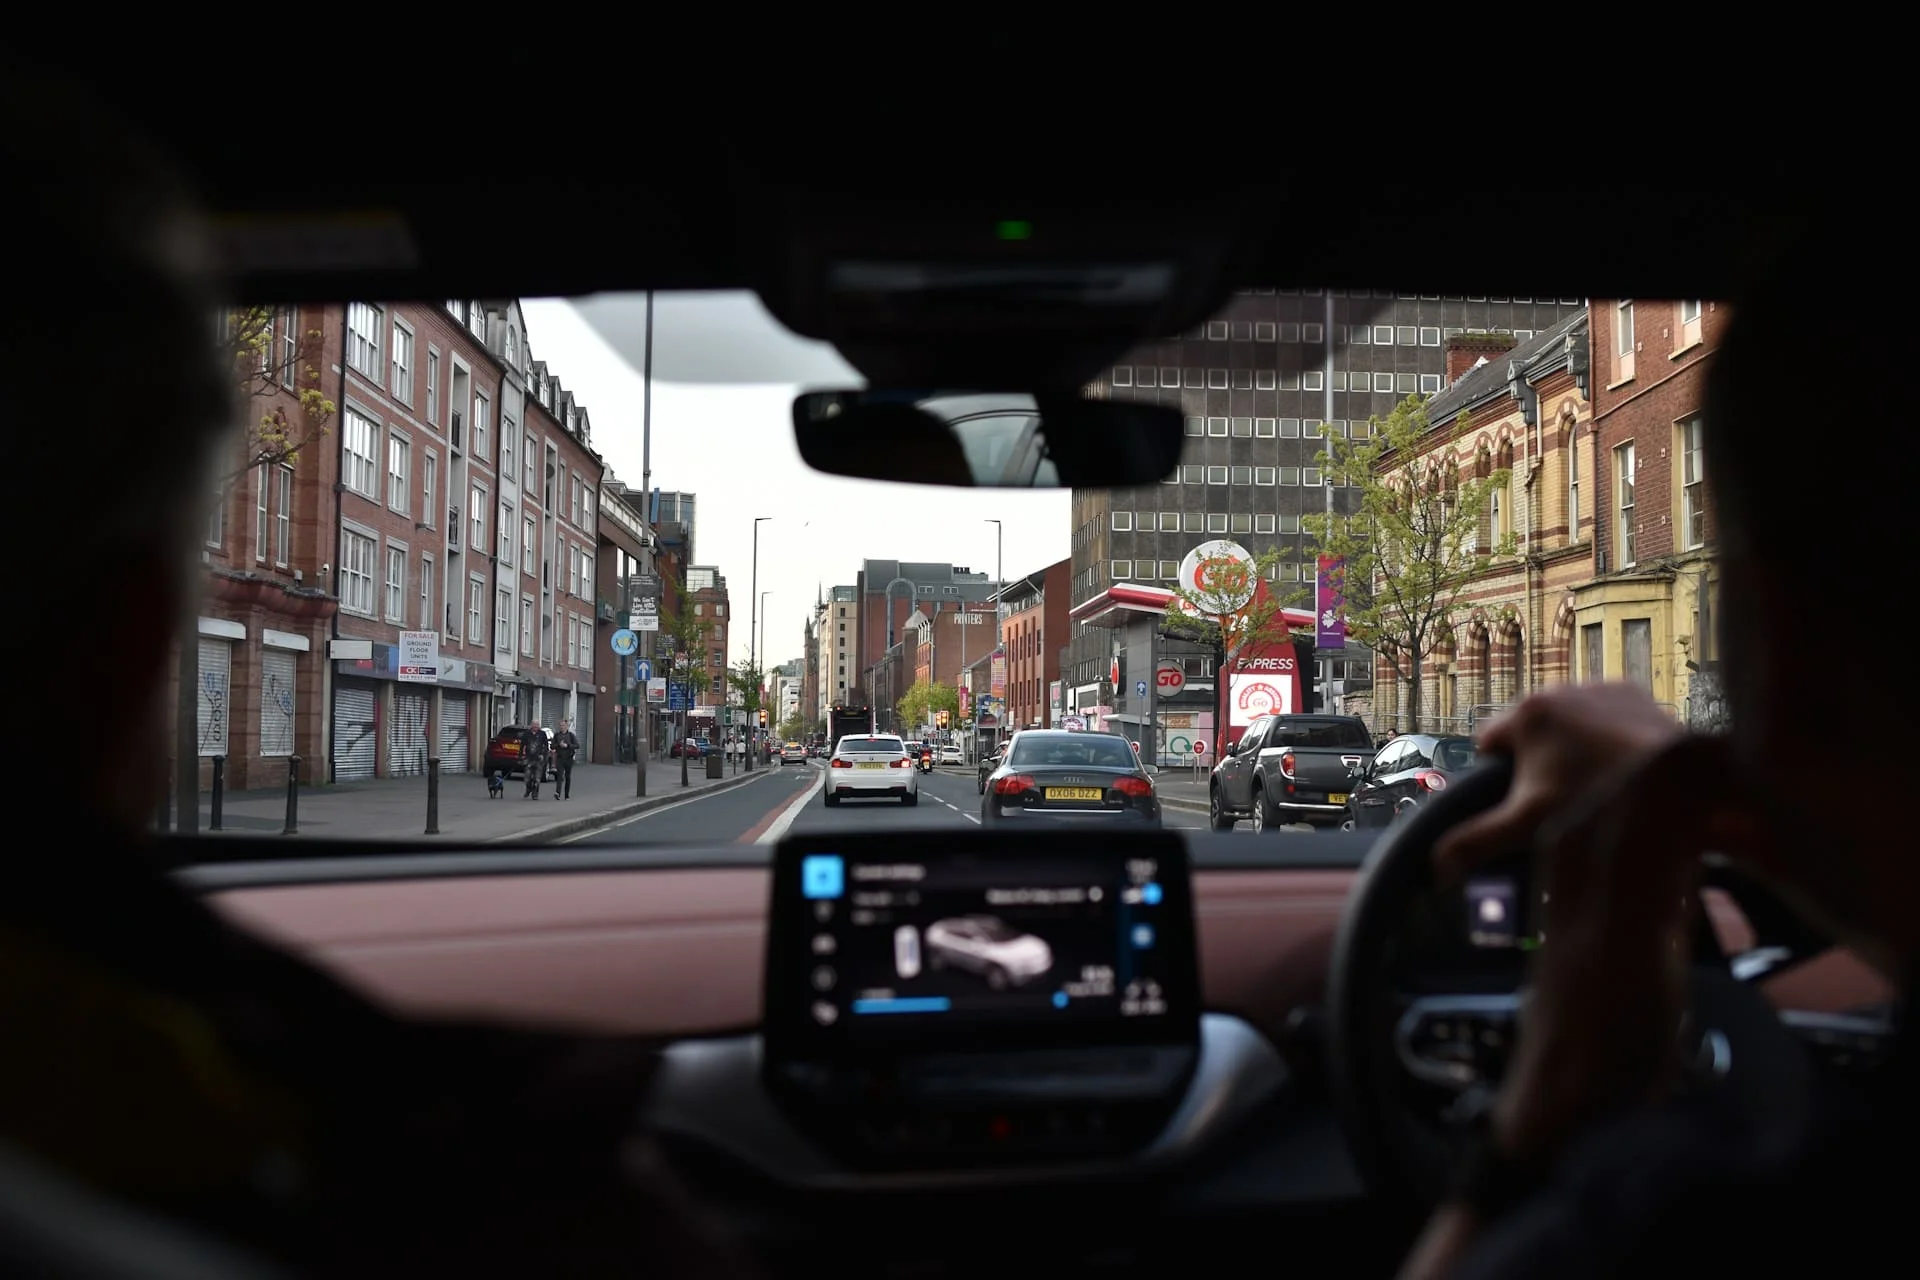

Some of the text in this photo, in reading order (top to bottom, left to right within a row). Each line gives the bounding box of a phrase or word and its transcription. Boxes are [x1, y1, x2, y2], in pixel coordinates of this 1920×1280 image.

[953, 613, 983, 625] PRINTERS
[1236, 658, 1294, 670] EXPRESS
[1156, 668, 1183, 687] GO
[1049, 788, 1098, 798] OX06 DZZ
